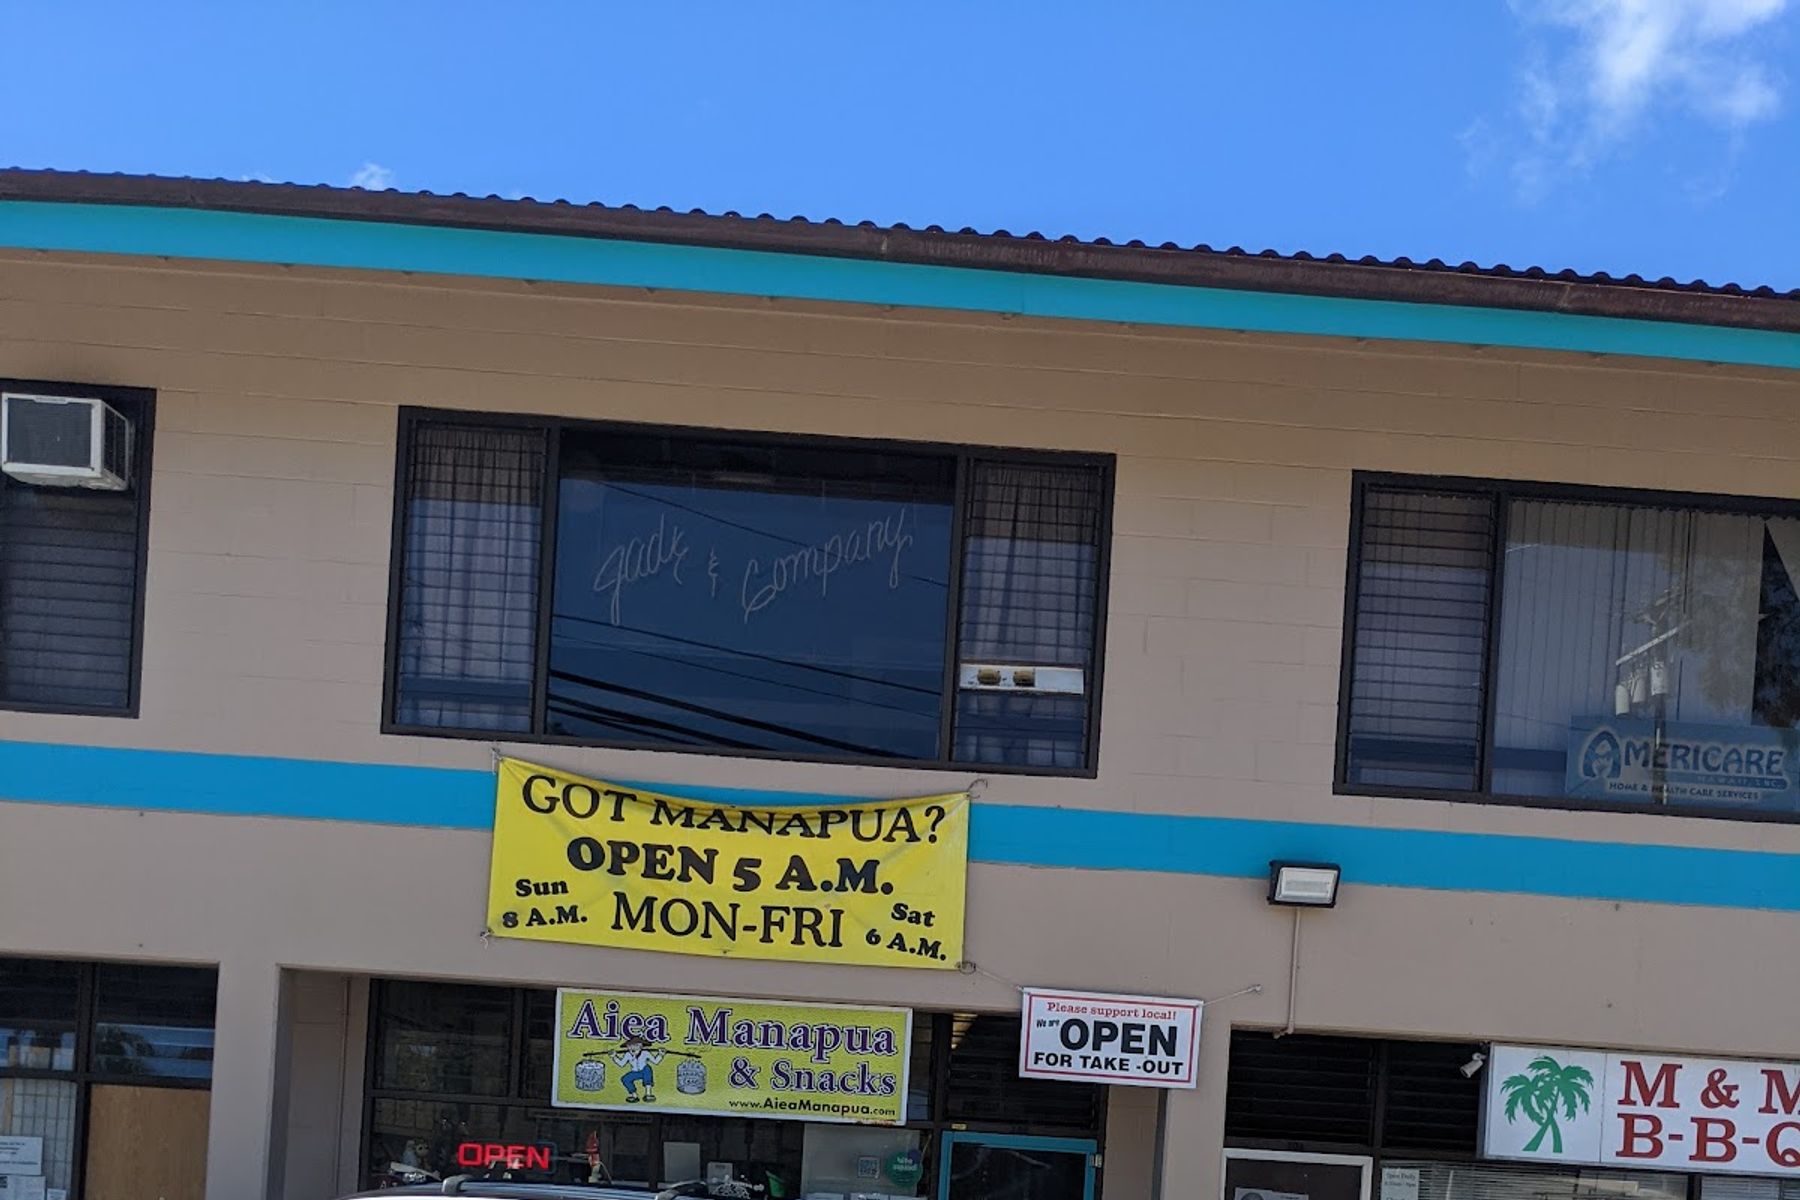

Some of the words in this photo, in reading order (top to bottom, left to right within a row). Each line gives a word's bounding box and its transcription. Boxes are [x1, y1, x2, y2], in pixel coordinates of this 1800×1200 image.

[742, 508, 913, 624] Company
[1582, 730, 1784, 776] AMERICARE
[1609, 781, 1638, 791] HOME
[1689, 786, 1714, 797] CARE
[521, 775, 638, 822] GOT
[650, 800, 947, 845] MANAPUA?
[567, 836, 719, 884] OPEN
[732, 858, 763, 893] 5
[775, 855, 895, 896] A.M.
[515, 876, 570, 897] Sun
[502, 911, 519, 929] 8
[525, 905, 588, 927] A.M.
[611, 891, 846, 949] MON-FRI
[891, 902, 937, 928] Sat
[866, 928, 882, 946] 6
[887, 933, 948, 962] A.M.
[1047, 1002, 1088, 1014] Please
[1090, 1007, 1138, 1019] support
[1141, 1009, 1177, 1021] local!
[567, 1001, 670, 1043] Aiea
[686, 1006, 898, 1064] Manapua
[1060, 1018, 1178, 1057] OPEN
[728, 1057, 762, 1090] &
[770, 1058, 897, 1096] Snacks
[1033, 1052, 1073, 1068] FOR
[1080, 1056, 1130, 1071] TAKE
[1617, 1060, 1683, 1109] M
[1700, 1068, 1740, 1109] &
[729, 1096, 896, 1117] www.AieaManapua.com
[458, 1142, 549, 1170] OPEN
